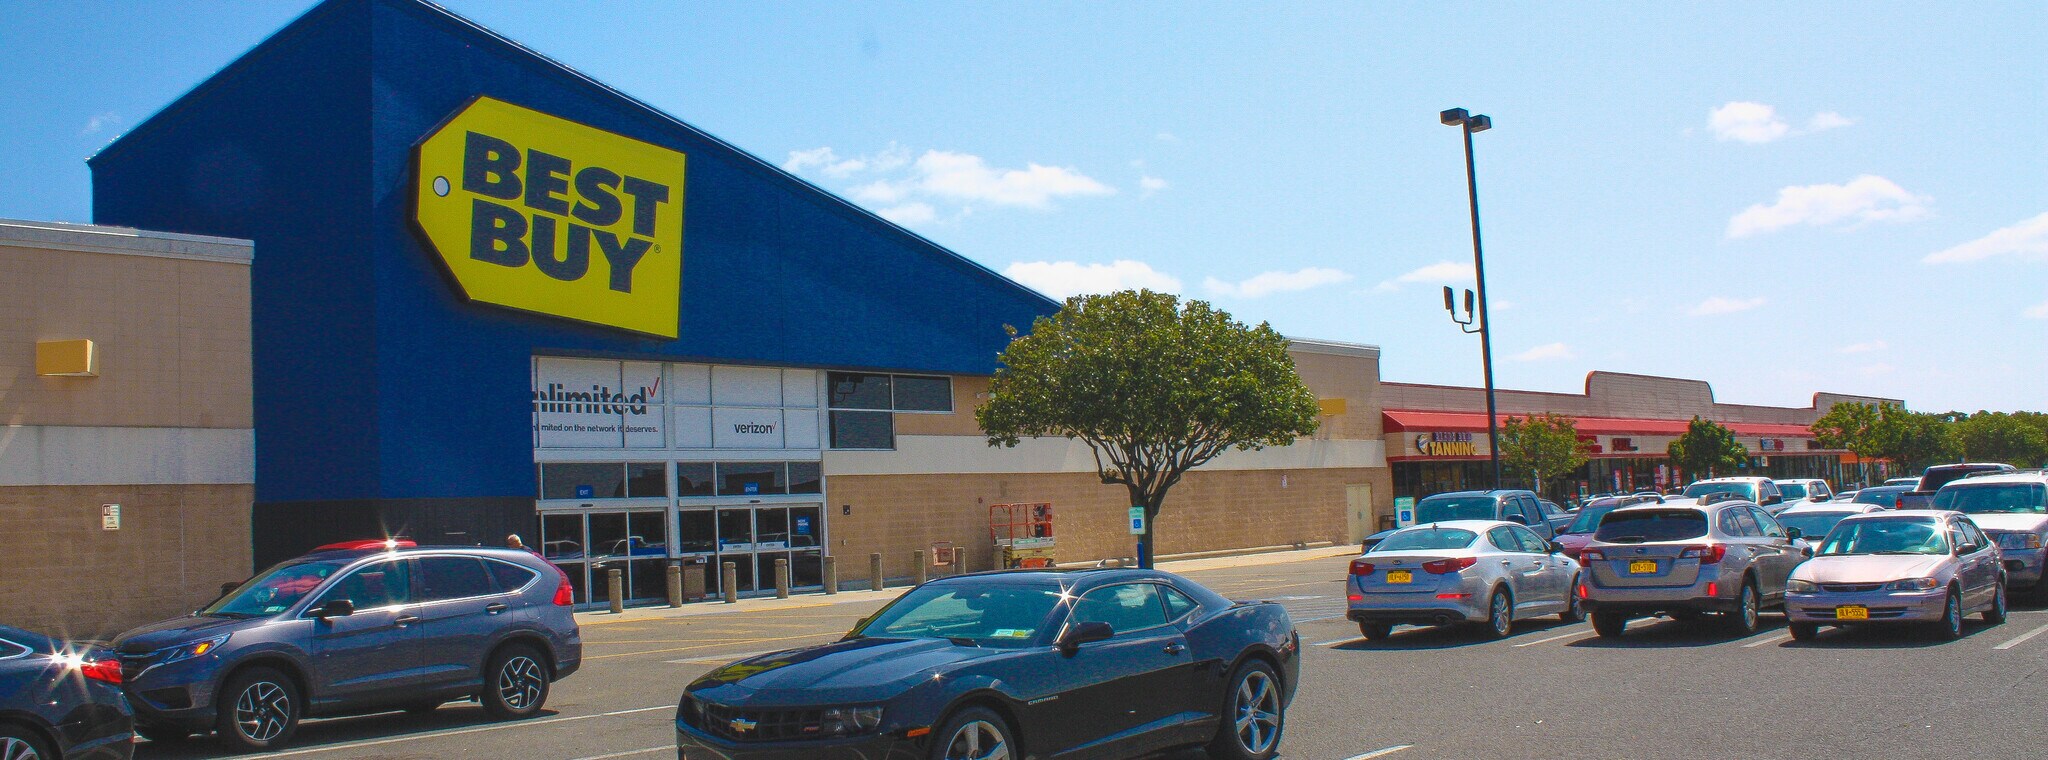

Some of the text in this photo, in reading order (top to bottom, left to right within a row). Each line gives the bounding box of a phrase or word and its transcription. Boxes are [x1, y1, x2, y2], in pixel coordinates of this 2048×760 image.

[462, 130, 669, 237] BEST
[469, 197, 654, 294] BUY
[574, 424, 586, 432] the
[587, 424, 616, 432] network
[625, 424, 659, 433] deserves.
[734, 421, 773, 434] verizon
[1430, 441, 1478, 456] TANNING
